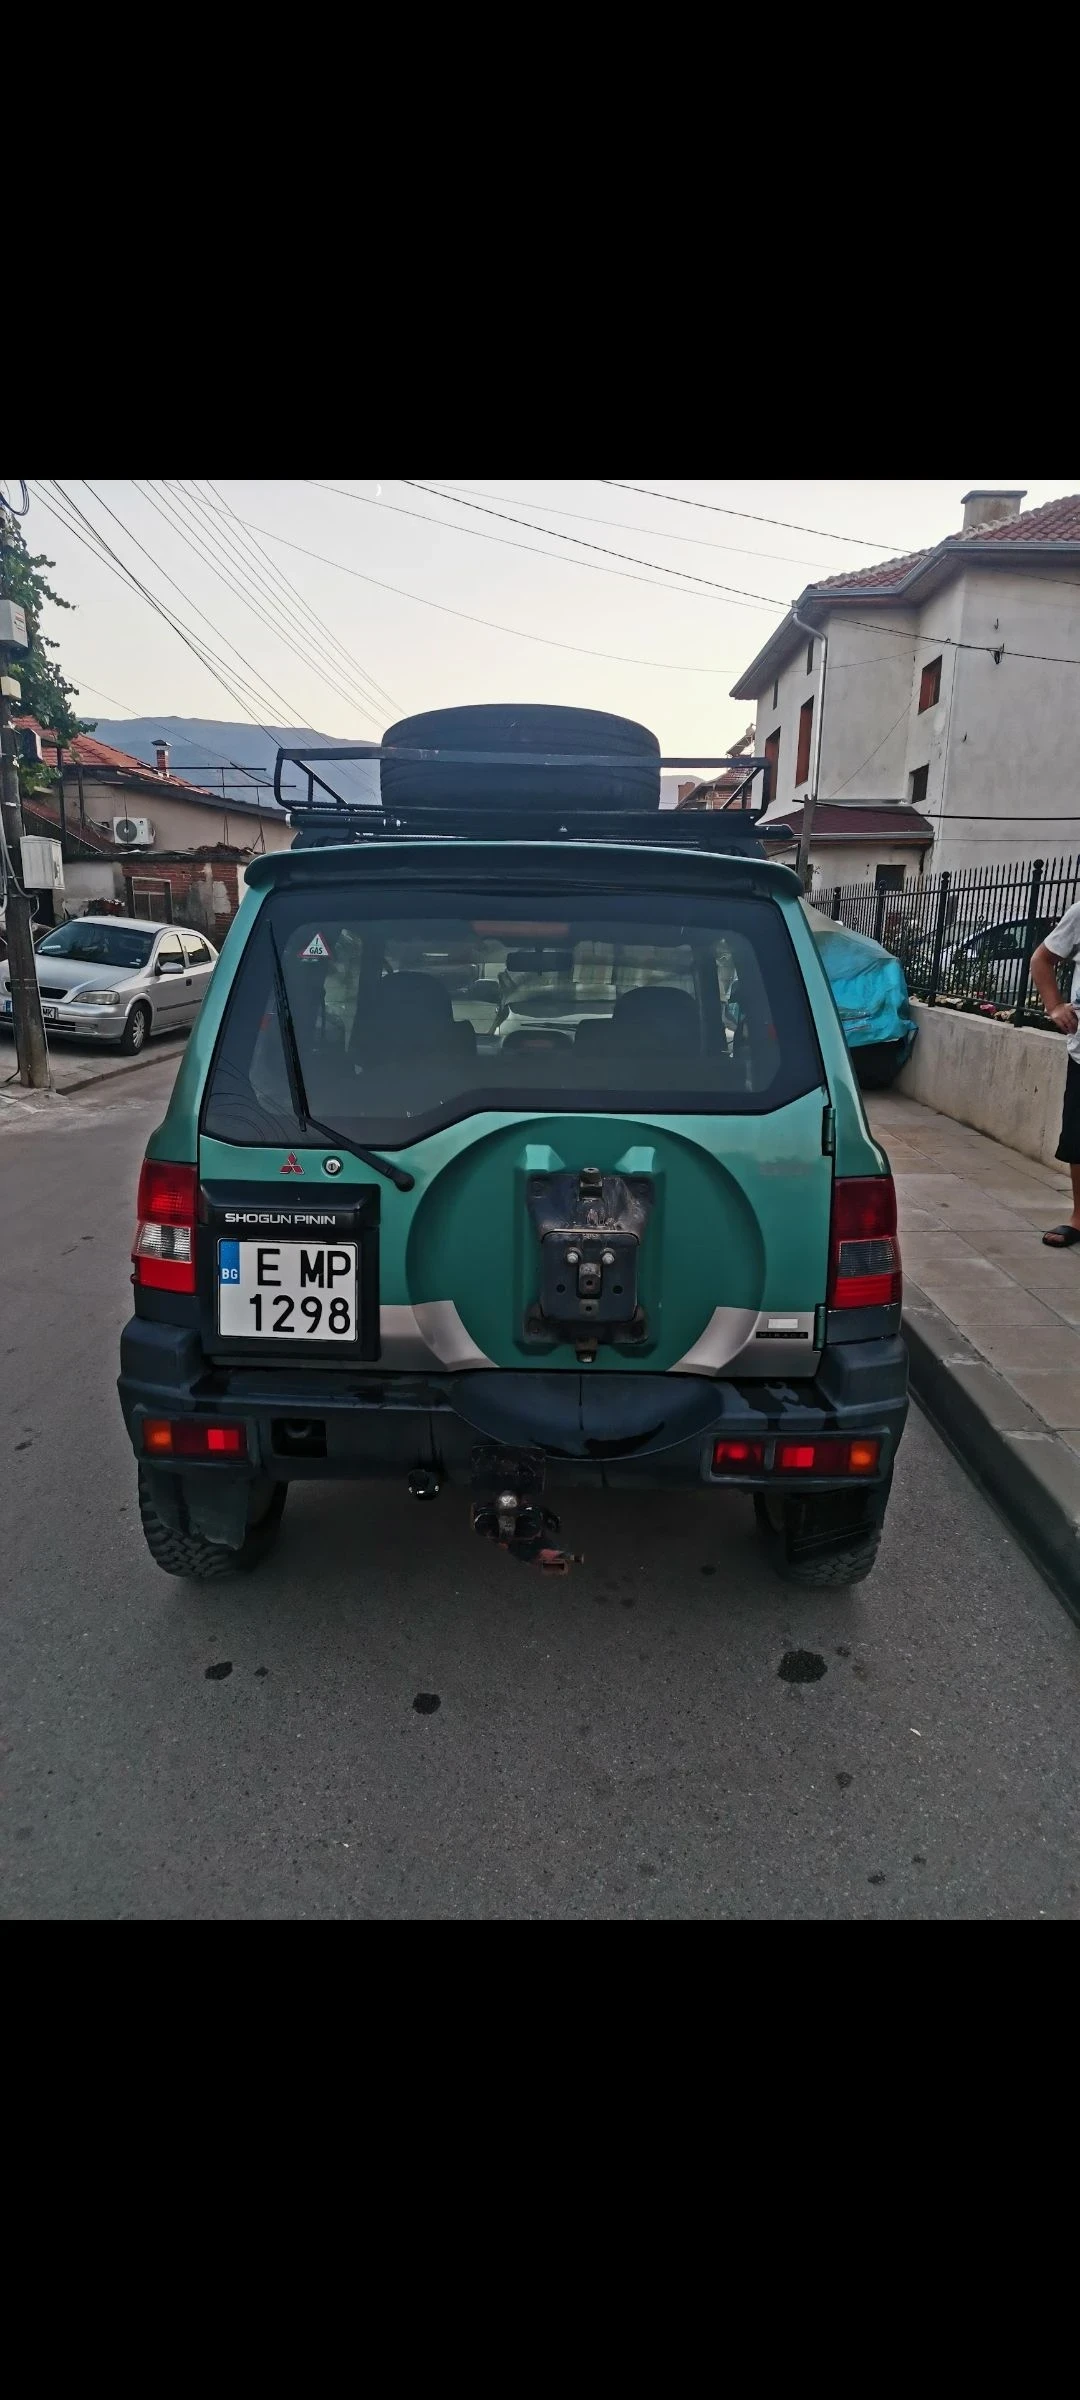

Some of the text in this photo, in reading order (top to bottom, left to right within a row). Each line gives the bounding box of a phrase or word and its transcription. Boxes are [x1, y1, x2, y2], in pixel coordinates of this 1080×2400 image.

[224, 1212, 336, 1225] SHOGUN PININ
[221, 1268, 238, 1280] BG
[257, 1247, 351, 1289] E MP
[249, 1293, 351, 1335] 1298
